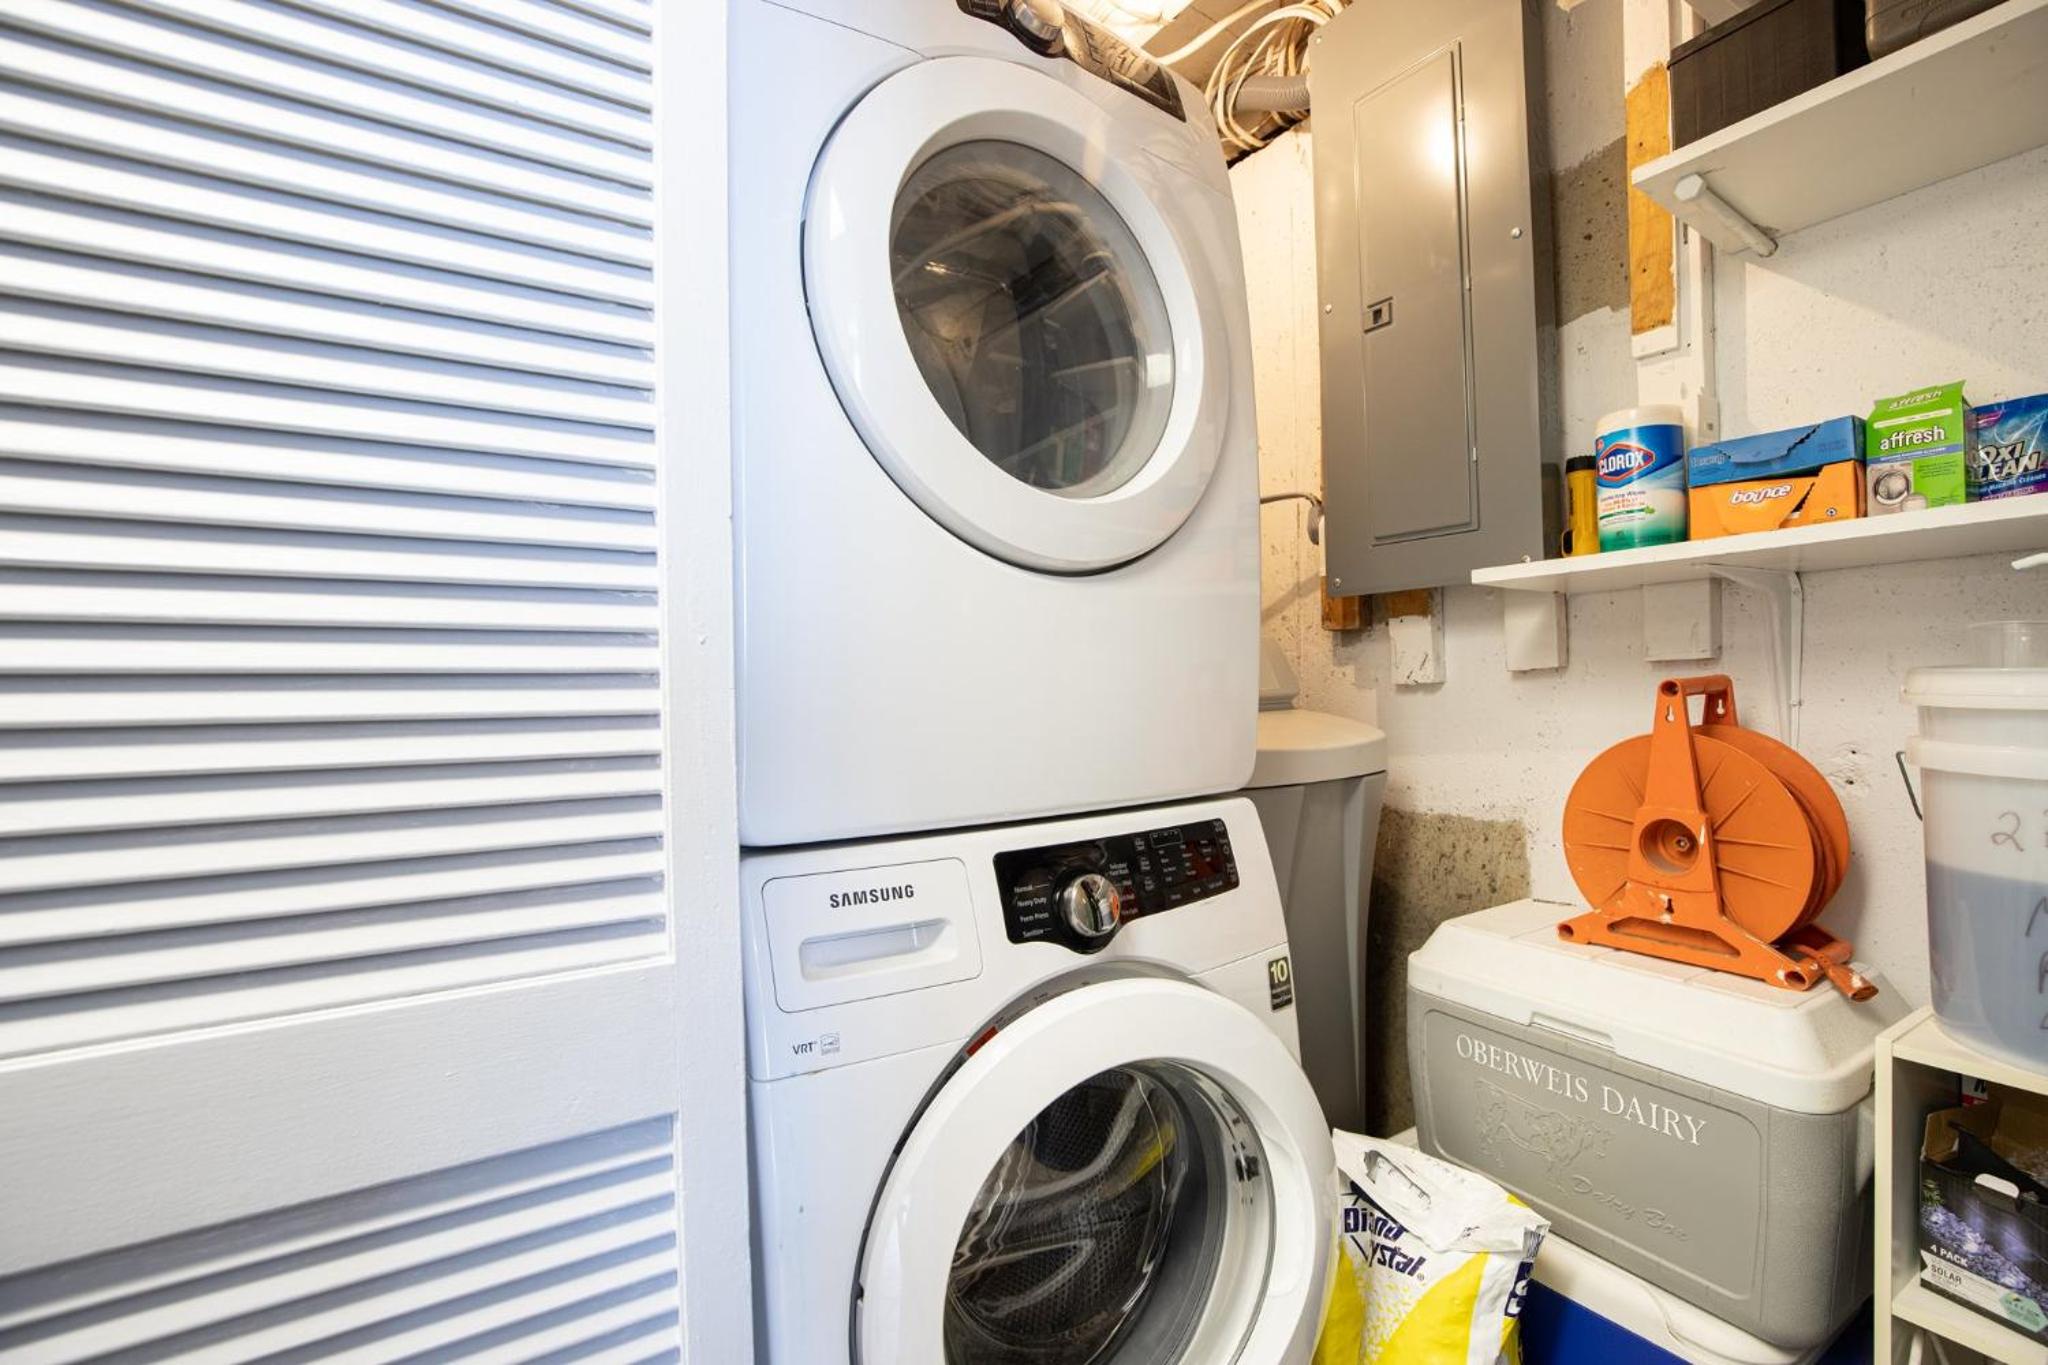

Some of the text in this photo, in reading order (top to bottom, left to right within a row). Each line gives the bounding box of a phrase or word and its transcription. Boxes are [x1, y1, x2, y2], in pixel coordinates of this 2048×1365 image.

[1880, 425, 1945, 450] affresh
[1598, 450, 1645, 475] CLOROX
[1730, 484, 1793, 504] bounce
[829, 884, 915, 909] SAMSUNG
[1270, 959, 1288, 983] 10
[1456, 1034, 1707, 1146] OBERWEIS DAIRY
[1929, 1244, 1969, 1268] 4 PACK
[1931, 1264, 1962, 1285] SOLAR
